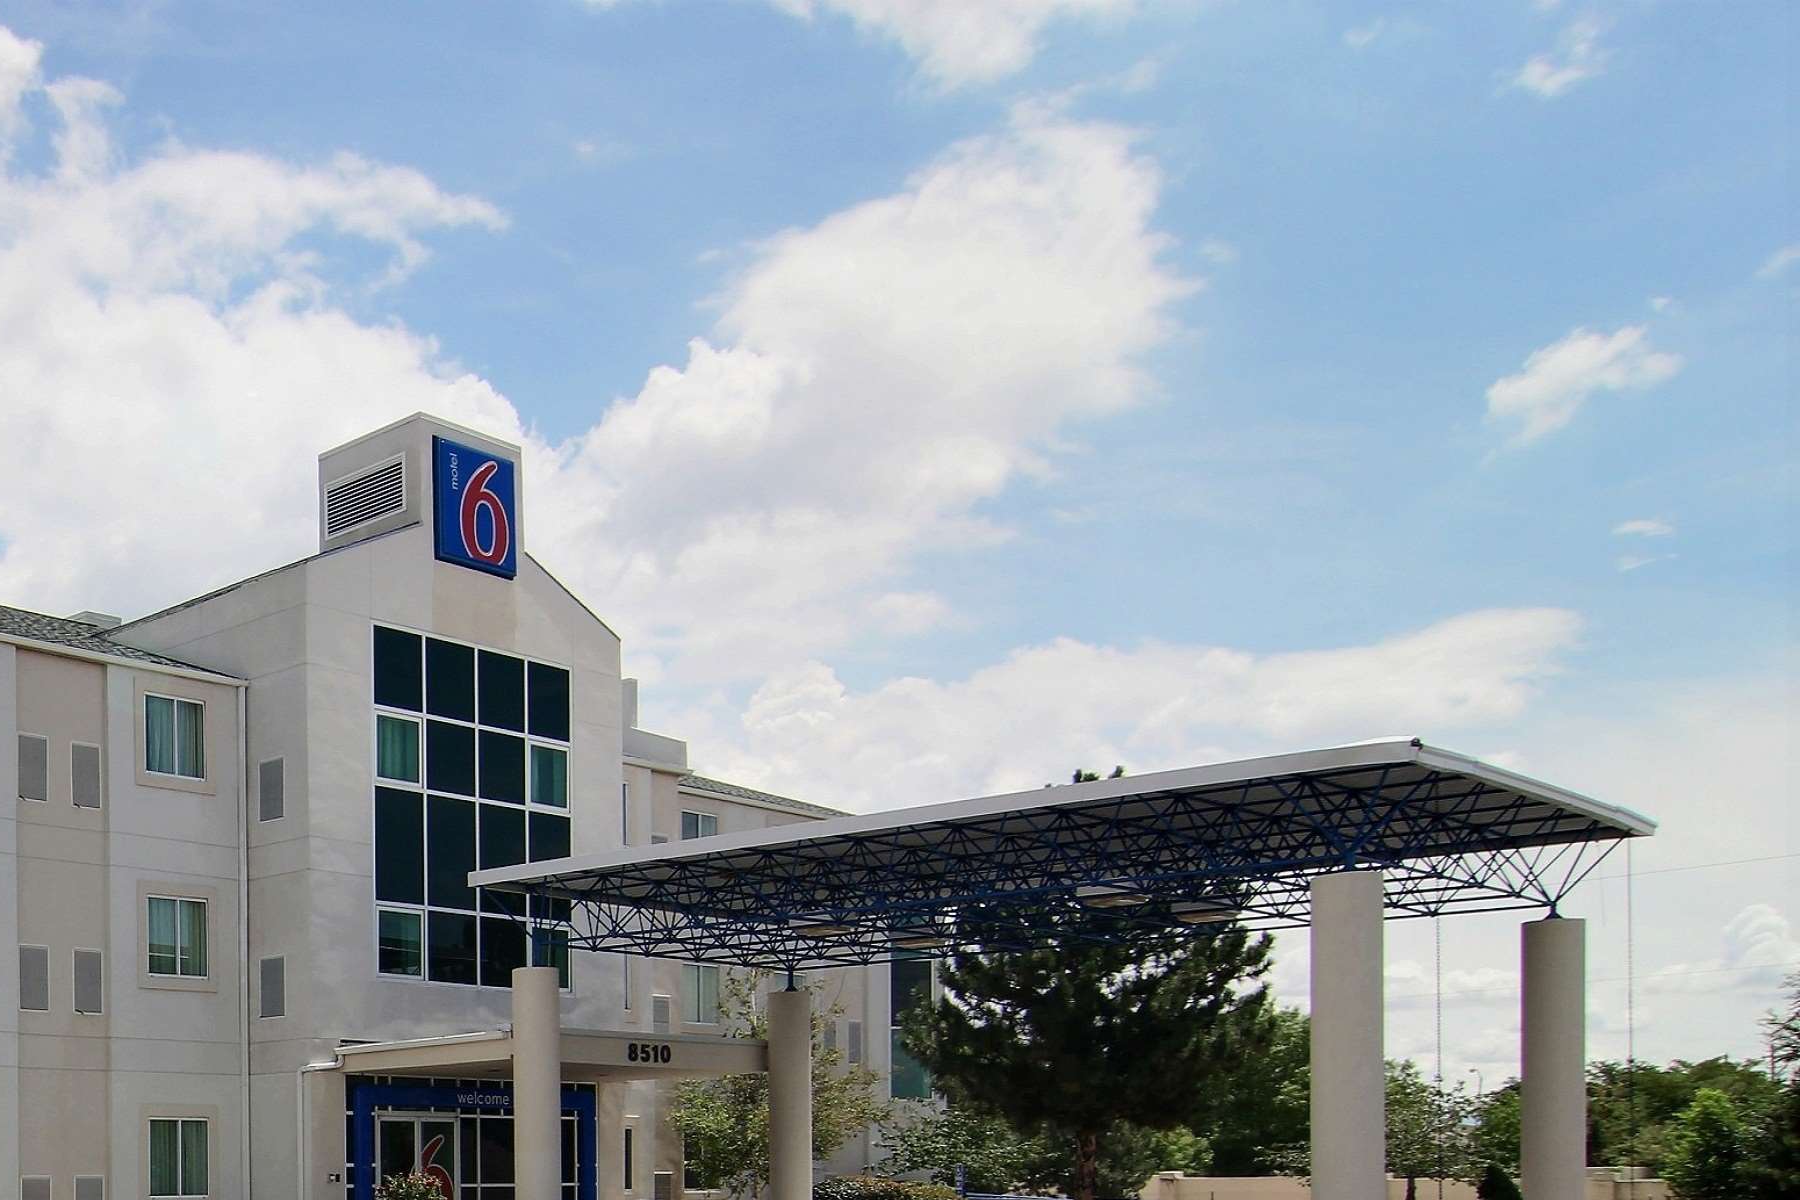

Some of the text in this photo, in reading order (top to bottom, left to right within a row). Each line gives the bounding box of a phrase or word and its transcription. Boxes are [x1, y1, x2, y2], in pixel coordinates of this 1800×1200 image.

[449, 453, 458, 490] motel
[460, 460, 509, 566] 6
[628, 1043, 671, 1064] 8510
[457, 1091, 510, 1105] welcome
